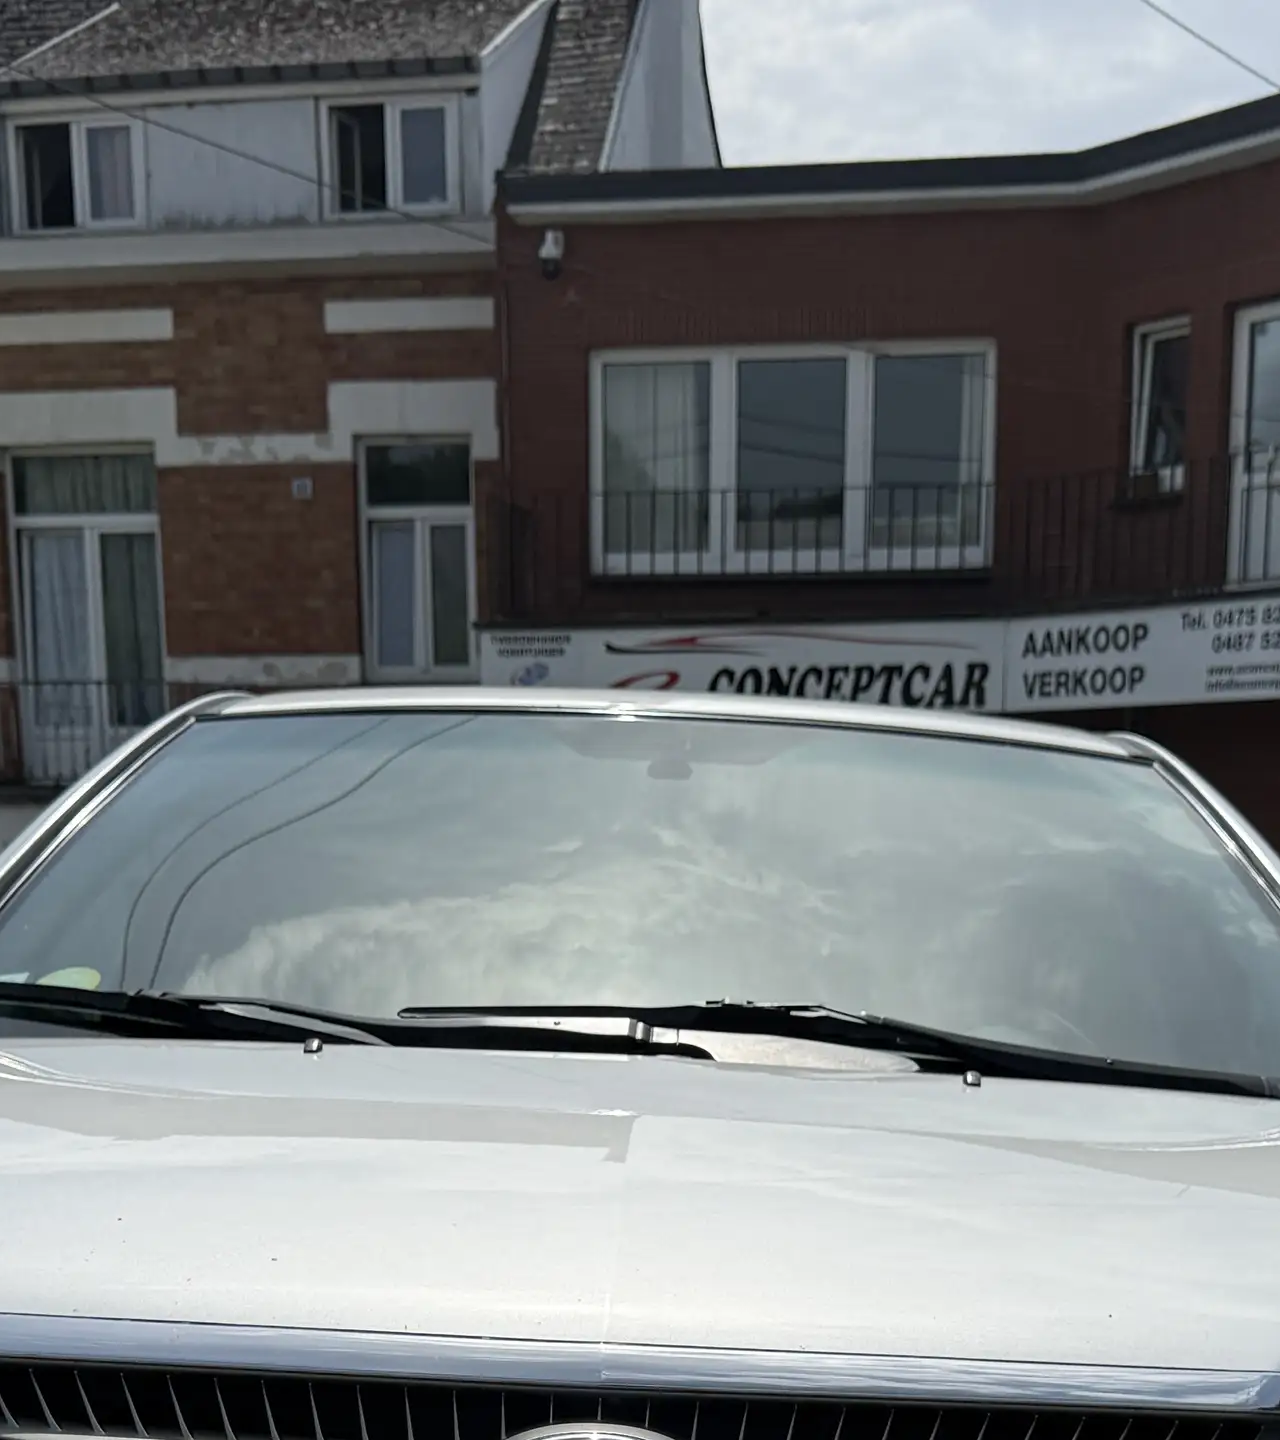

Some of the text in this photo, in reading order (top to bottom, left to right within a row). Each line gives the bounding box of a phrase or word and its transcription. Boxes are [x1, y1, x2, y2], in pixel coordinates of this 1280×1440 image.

[1181, 611, 1206, 631] Tel.
[1213, 605, 1256, 629] 0475
[1021, 622, 1148, 659] AANKOOP
[1212, 631, 1255, 654] 0487
[707, 662, 990, 708] CONCEPTCAR
[1022, 664, 1145, 699] VERKOOP
